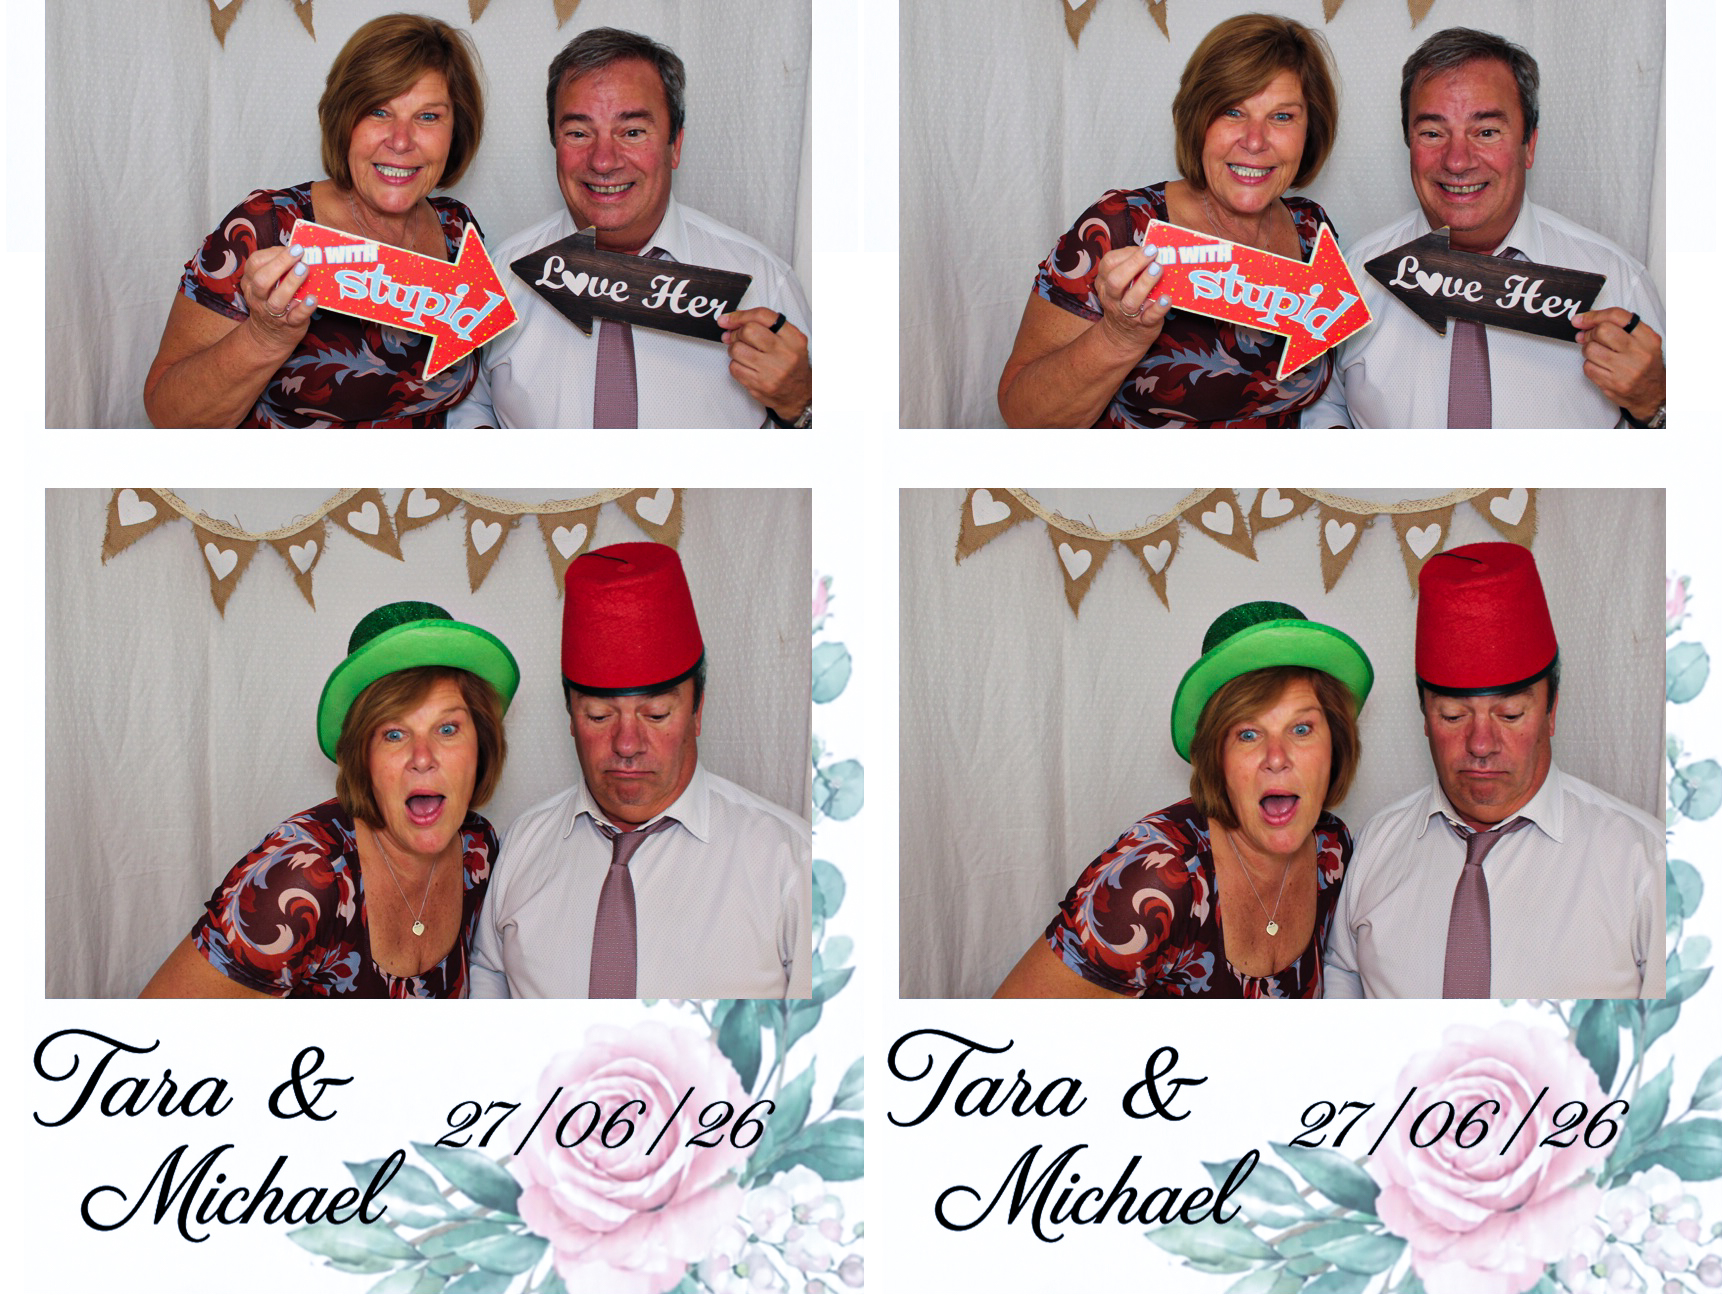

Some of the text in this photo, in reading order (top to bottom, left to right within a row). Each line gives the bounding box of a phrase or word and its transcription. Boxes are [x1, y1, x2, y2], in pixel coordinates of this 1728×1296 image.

[325, 243, 379, 265] WITH
[1179, 243, 1233, 265] WITH
[334, 263, 506, 342] stupid
[641, 274, 729, 322] Her
[1188, 263, 1360, 342] stupid
[1495, 274, 1583, 322] Her
